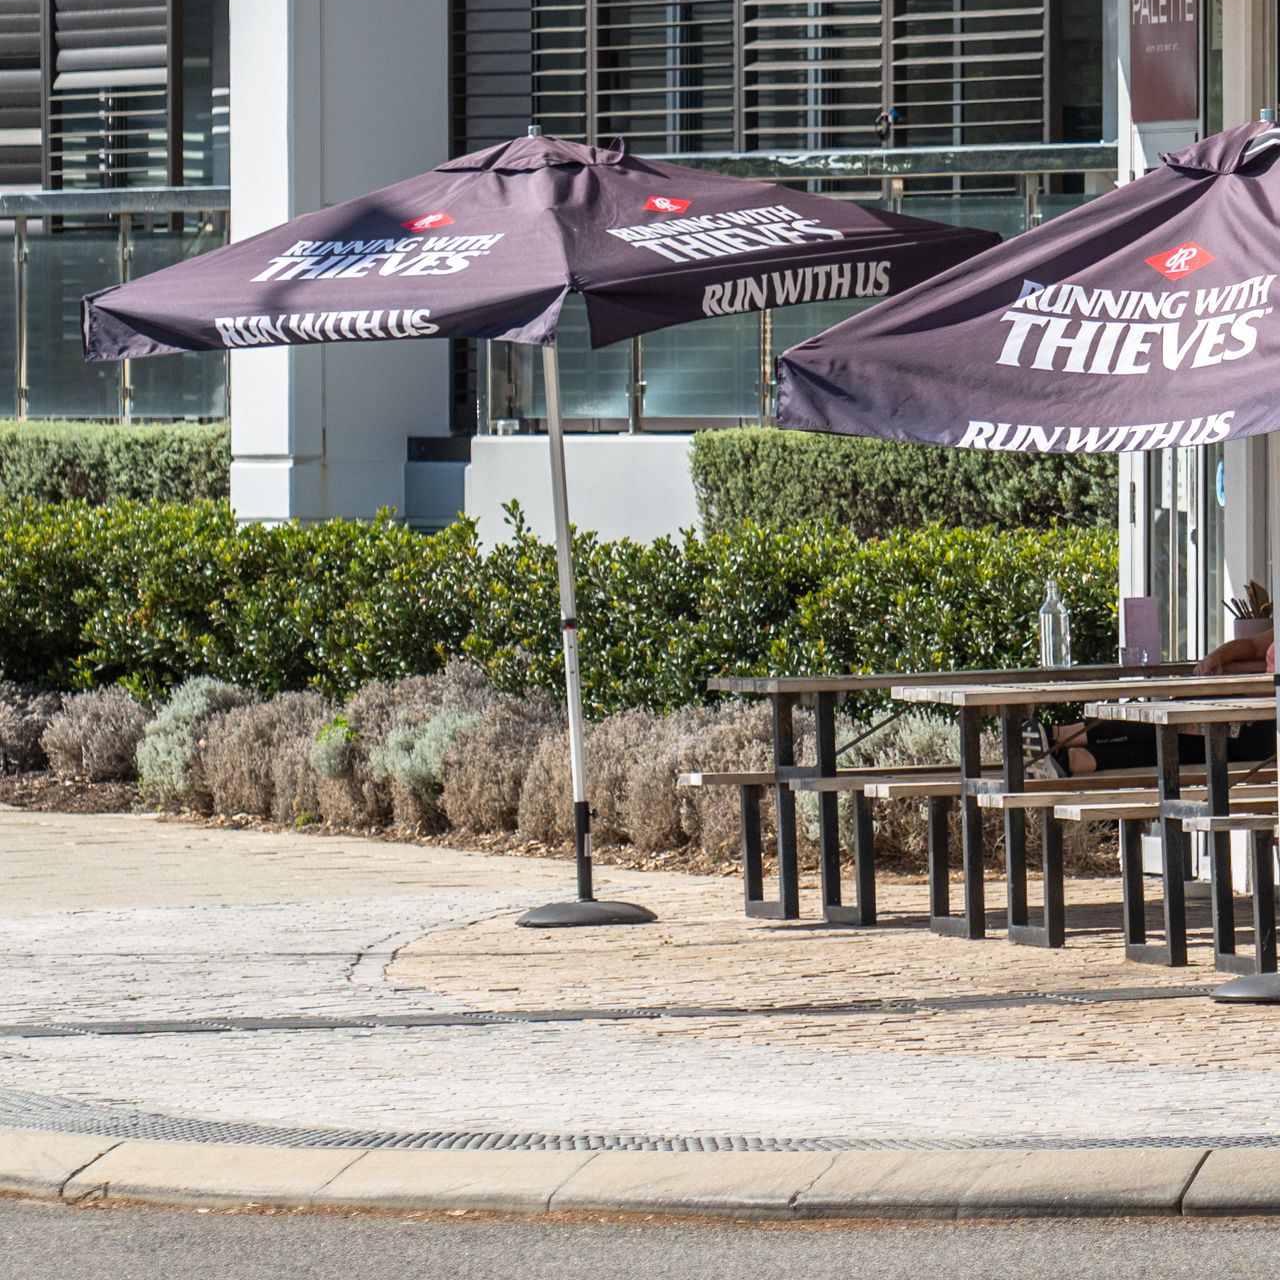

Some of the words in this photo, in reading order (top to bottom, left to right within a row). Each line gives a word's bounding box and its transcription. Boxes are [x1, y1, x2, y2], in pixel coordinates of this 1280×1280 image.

[282, 237, 424, 256] RUNNING
[422, 233, 505, 251] WITH
[606, 212, 736, 242] RUNNING
[721, 205, 803, 227] WITH
[631, 219, 846, 263] THIEVES
[250, 250, 482, 282] THIEVES
[702, 274, 770, 317] RUN
[771, 263, 851, 307] WITH
[855, 261, 891, 297] US
[1012, 279, 1190, 320] RUNNING
[1194, 274, 1278, 317] WITH
[215, 315, 291, 348] RUN
[289, 310, 387, 342] WITH
[387, 309, 440, 338] US
[996, 308, 1266, 375] THIEVES
[955, 420, 1065, 452] RUN
[1066, 420, 1186, 453] WITH
[1179, 410, 1235, 446] US
